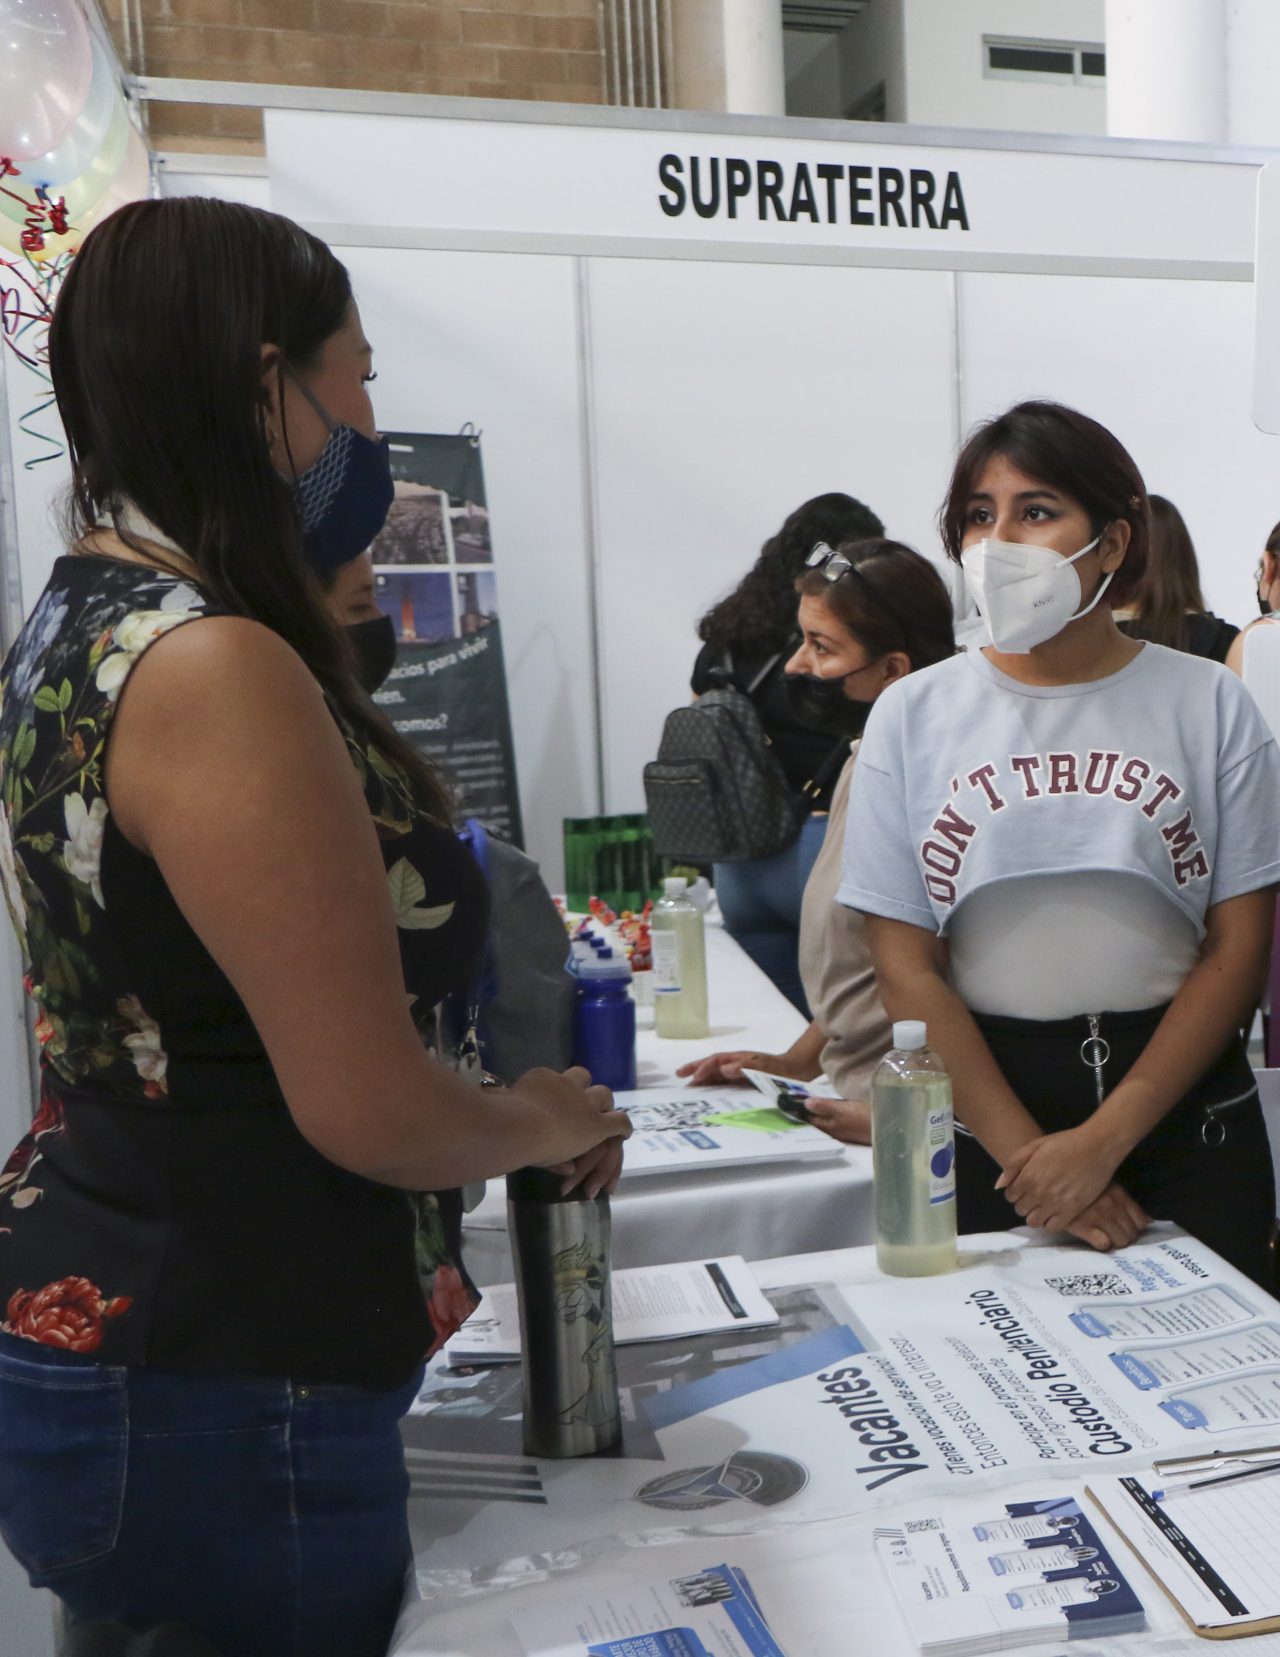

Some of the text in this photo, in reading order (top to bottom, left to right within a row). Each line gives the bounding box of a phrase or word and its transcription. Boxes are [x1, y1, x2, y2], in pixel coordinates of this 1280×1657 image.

[657, 153, 971, 231] SUPRATERRA
[427, 653, 458, 676] para
[458, 637, 489, 660] vivir
[1012, 751, 1182, 819] TRUST
[1161, 807, 1209, 887] ME
[924, 1379, 945, 1391] va
[963, 1288, 1136, 1456] Custodio Penitenciario
[896, 1387, 917, 1401] de
[935, 1391, 955, 1402] te
[939, 1401, 970, 1421] esto
[814, 1364, 928, 1490] Vacantes
[959, 1421, 1008, 1468] Entonces
